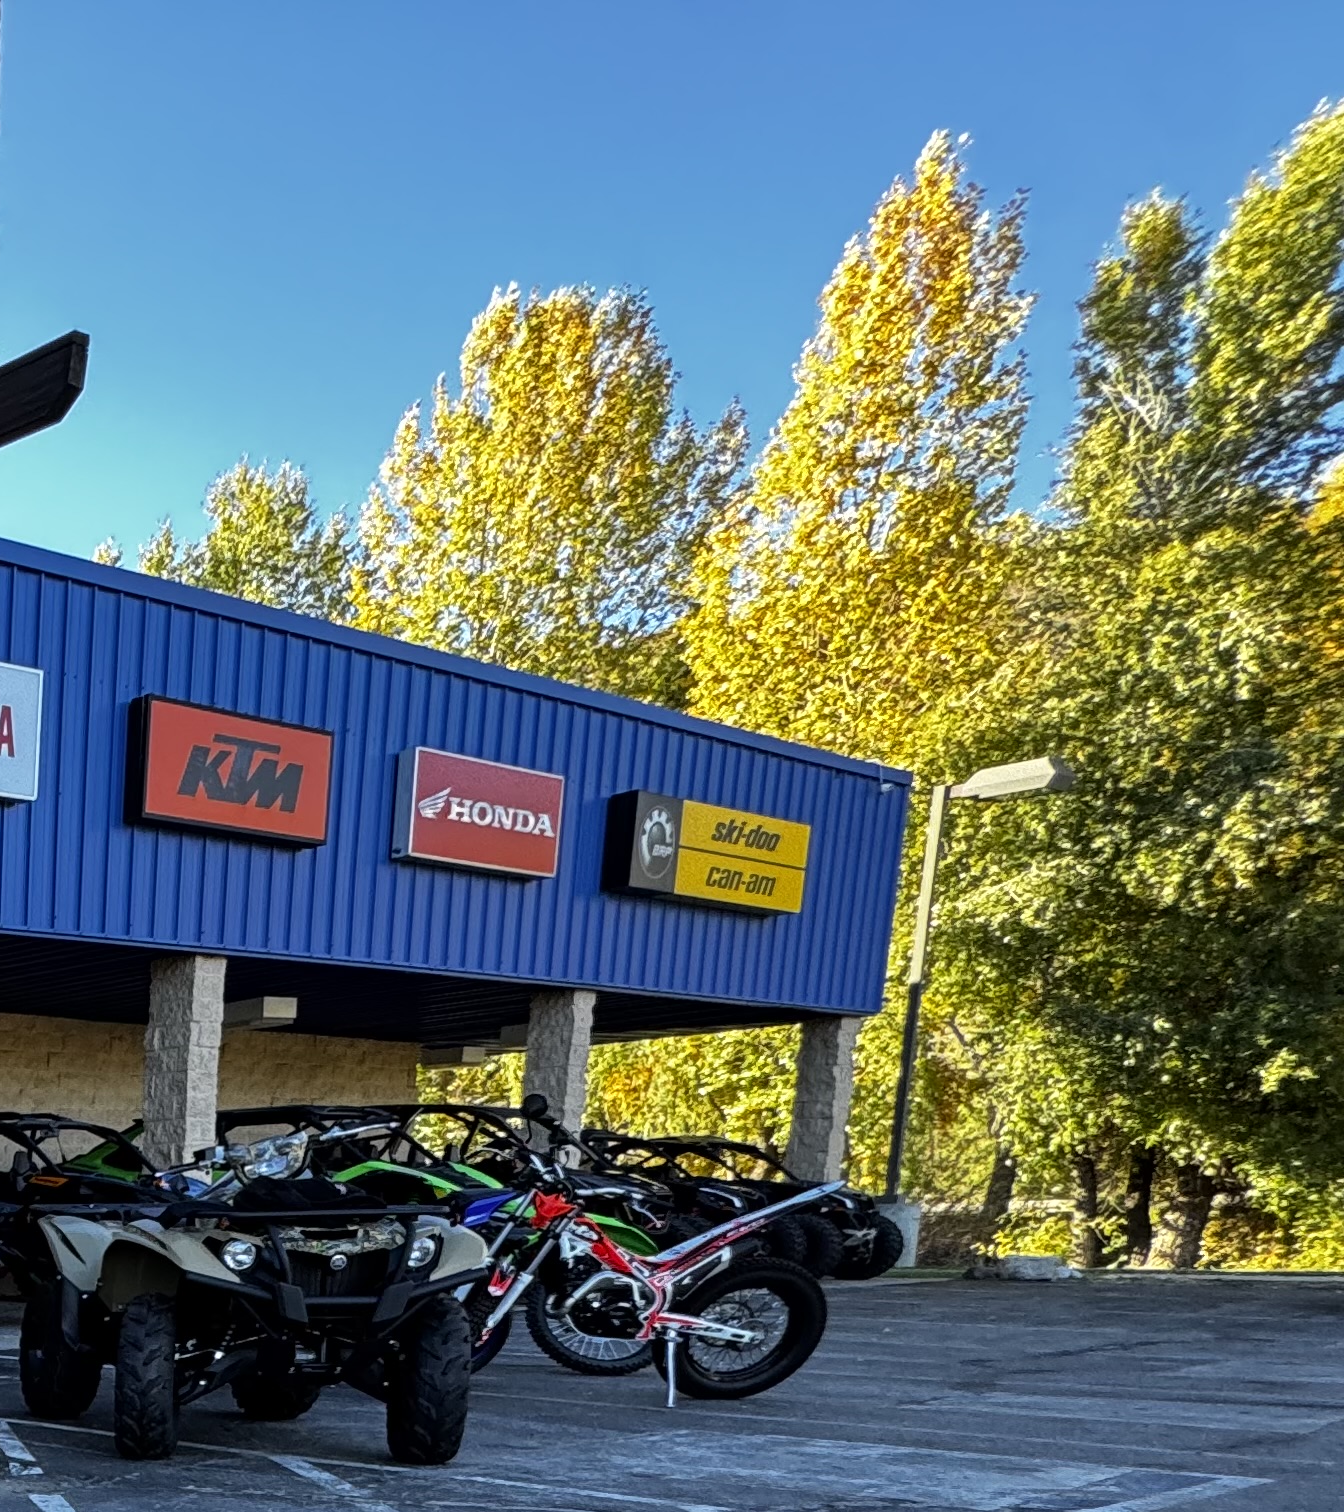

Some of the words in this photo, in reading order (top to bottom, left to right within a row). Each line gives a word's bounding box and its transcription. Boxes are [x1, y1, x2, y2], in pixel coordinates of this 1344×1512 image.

[178, 733, 304, 814] KTM
[446, 796, 555, 838] HONDA
[710, 818, 781, 852] ski-doo
[705, 866, 777, 897] can-am
